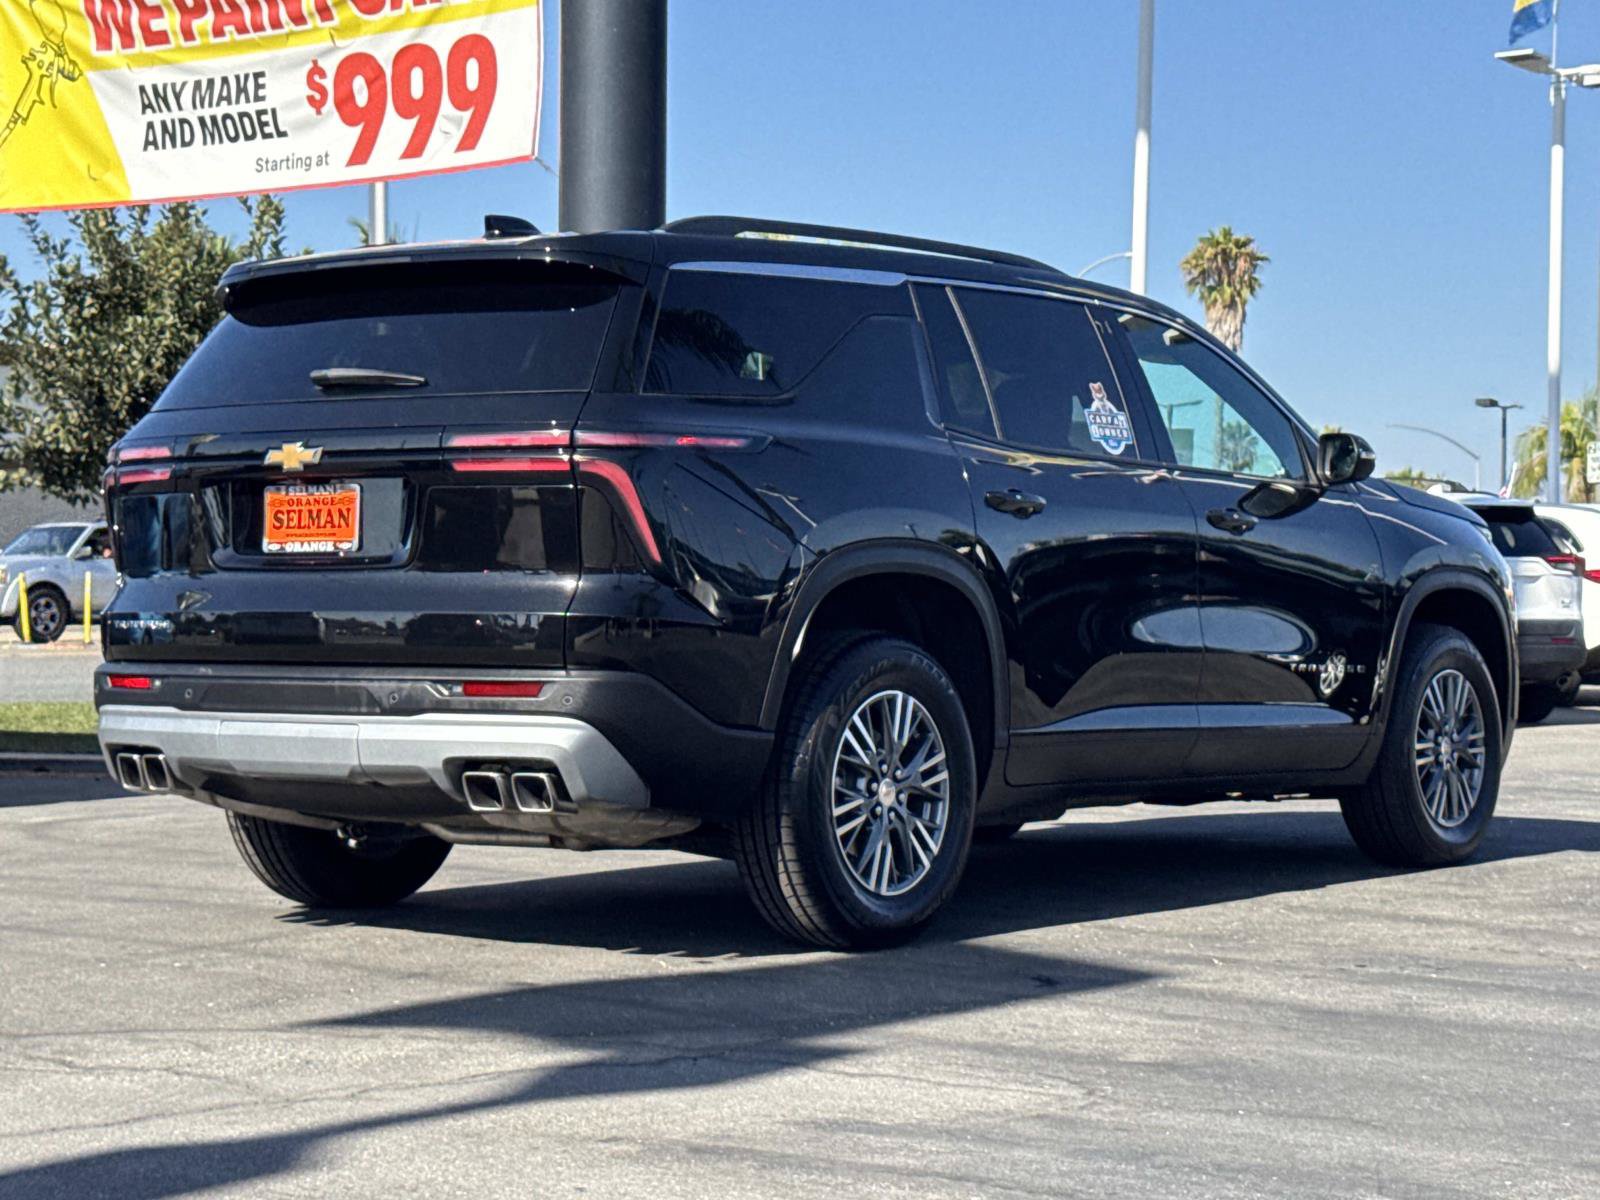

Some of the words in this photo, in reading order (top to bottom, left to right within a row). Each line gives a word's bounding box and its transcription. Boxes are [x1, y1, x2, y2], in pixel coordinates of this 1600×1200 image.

[84, 0, 171, 51] WE
[138, 80, 188, 115] ANY
[191, 71, 267, 110] MAKE
[306, 33, 498, 167] $999
[143, 117, 196, 152] AND
[197, 107, 289, 146] MODEL
[255, 153, 312, 173] Starting
[316, 151, 330, 167] at
[288, 484, 335, 495] SELMAN
[287, 497, 336, 506] ORANGE
[273, 508, 351, 530] SELMAN
[285, 541, 334, 552] ORANGE
